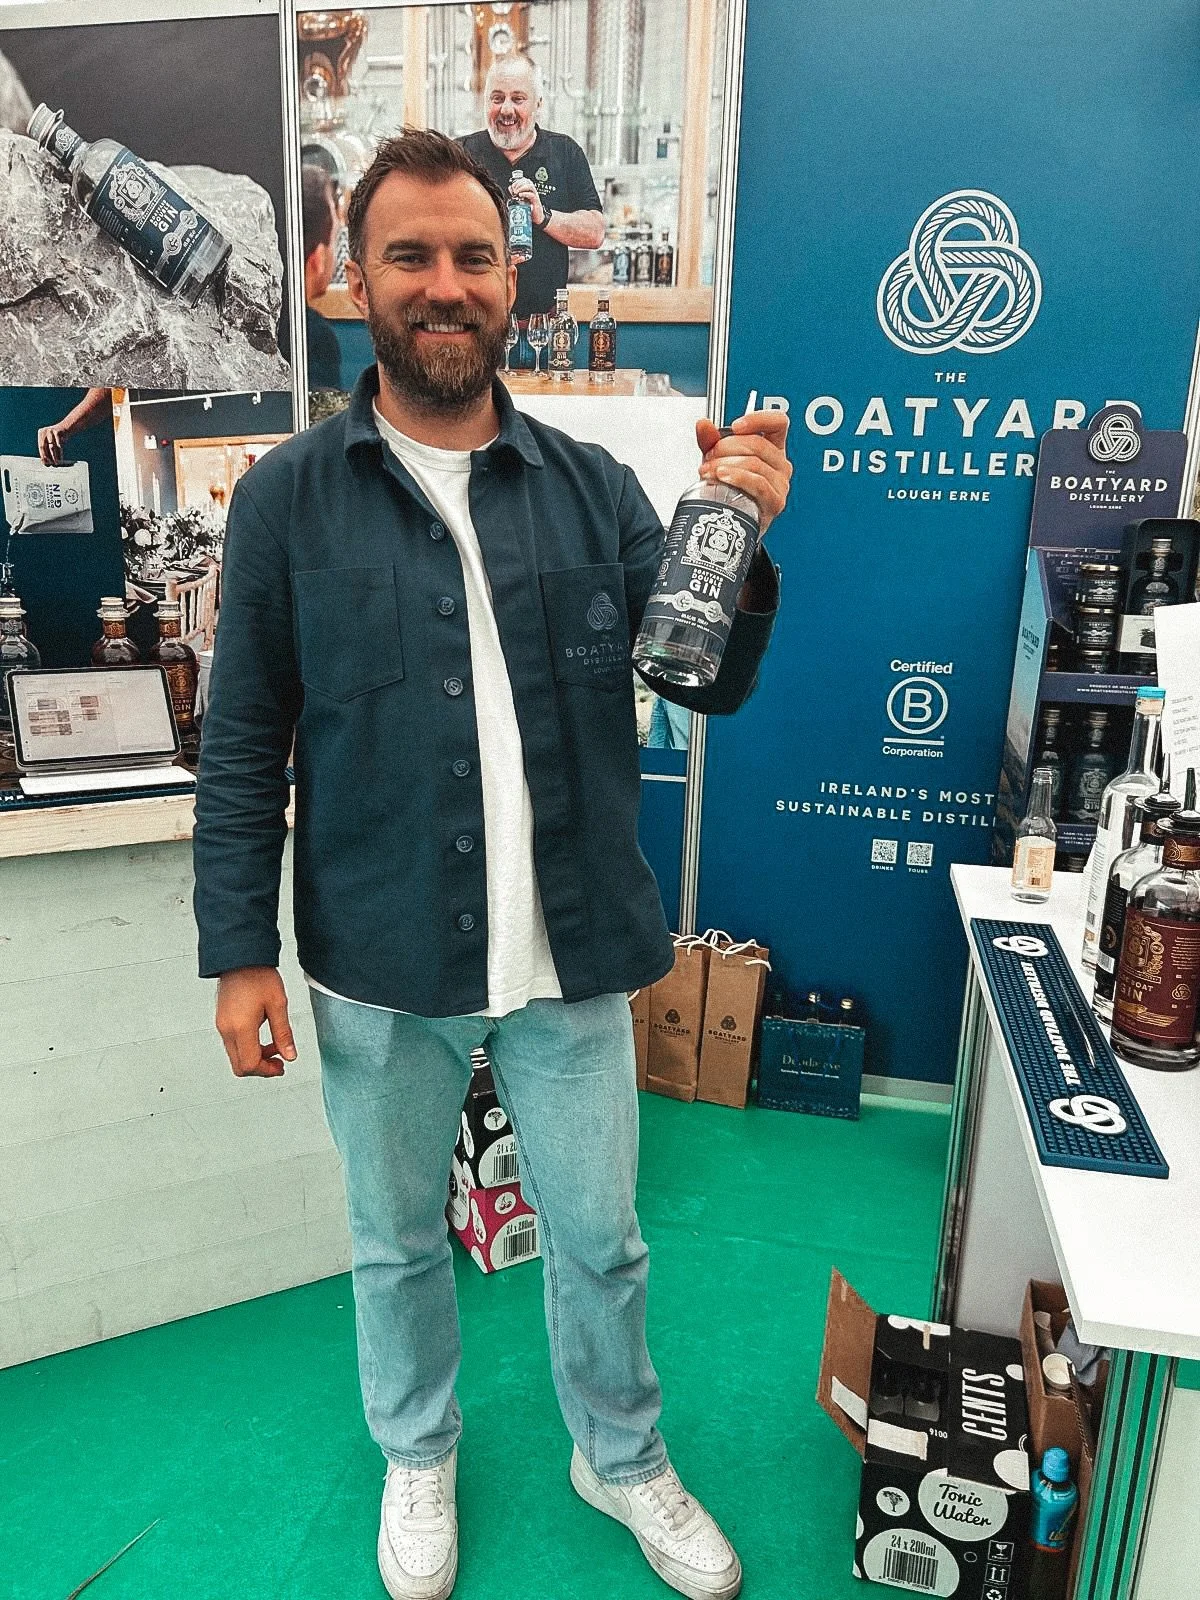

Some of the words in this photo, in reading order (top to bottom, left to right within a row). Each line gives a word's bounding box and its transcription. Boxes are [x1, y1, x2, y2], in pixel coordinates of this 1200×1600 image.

[158, 205, 178, 232] GIN
[934, 372, 967, 383] THE
[763, 395, 1142, 439] OATYAR
[822, 449, 1035, 477] DISTILLER
[1050, 476, 1168, 492] BOATYARD
[53, 484, 62, 508] GIN
[887, 489, 942, 501] LOUGH
[949, 490, 991, 502] ERNE
[1069, 493, 1145, 503] DISTILLERY
[691, 573, 723, 588] DOUBLE
[693, 568, 724, 583] BOATYARD
[689, 579, 721, 600] GIN
[890, 659, 953, 675] Certified
[174, 703, 191, 711] GIN
[902, 687, 933, 723] B
[882, 745, 944, 758] Corporation
[820, 781, 929, 800] IRELAND'S
[939, 790, 995, 805] MOST
[775, 800, 912, 821] SUSTAINABLE
[708, 1030, 747, 1041] BOATYARD
[1040, 1009, 1071, 1061] BOATYARD
[1060, 1062, 1080, 1085] THE
[506, 1224, 513, 1235] 24
[962, 1368, 1008, 1441] CENTS
[929, 1427, 948, 1439] 9100
[939, 1483, 983, 1507] Tonic
[933, 1501, 992, 1526] Water
[891, 1534, 902, 1549] 24
[903, 1541, 908, 1551] x
[910, 1539, 937, 1557] 200ml
